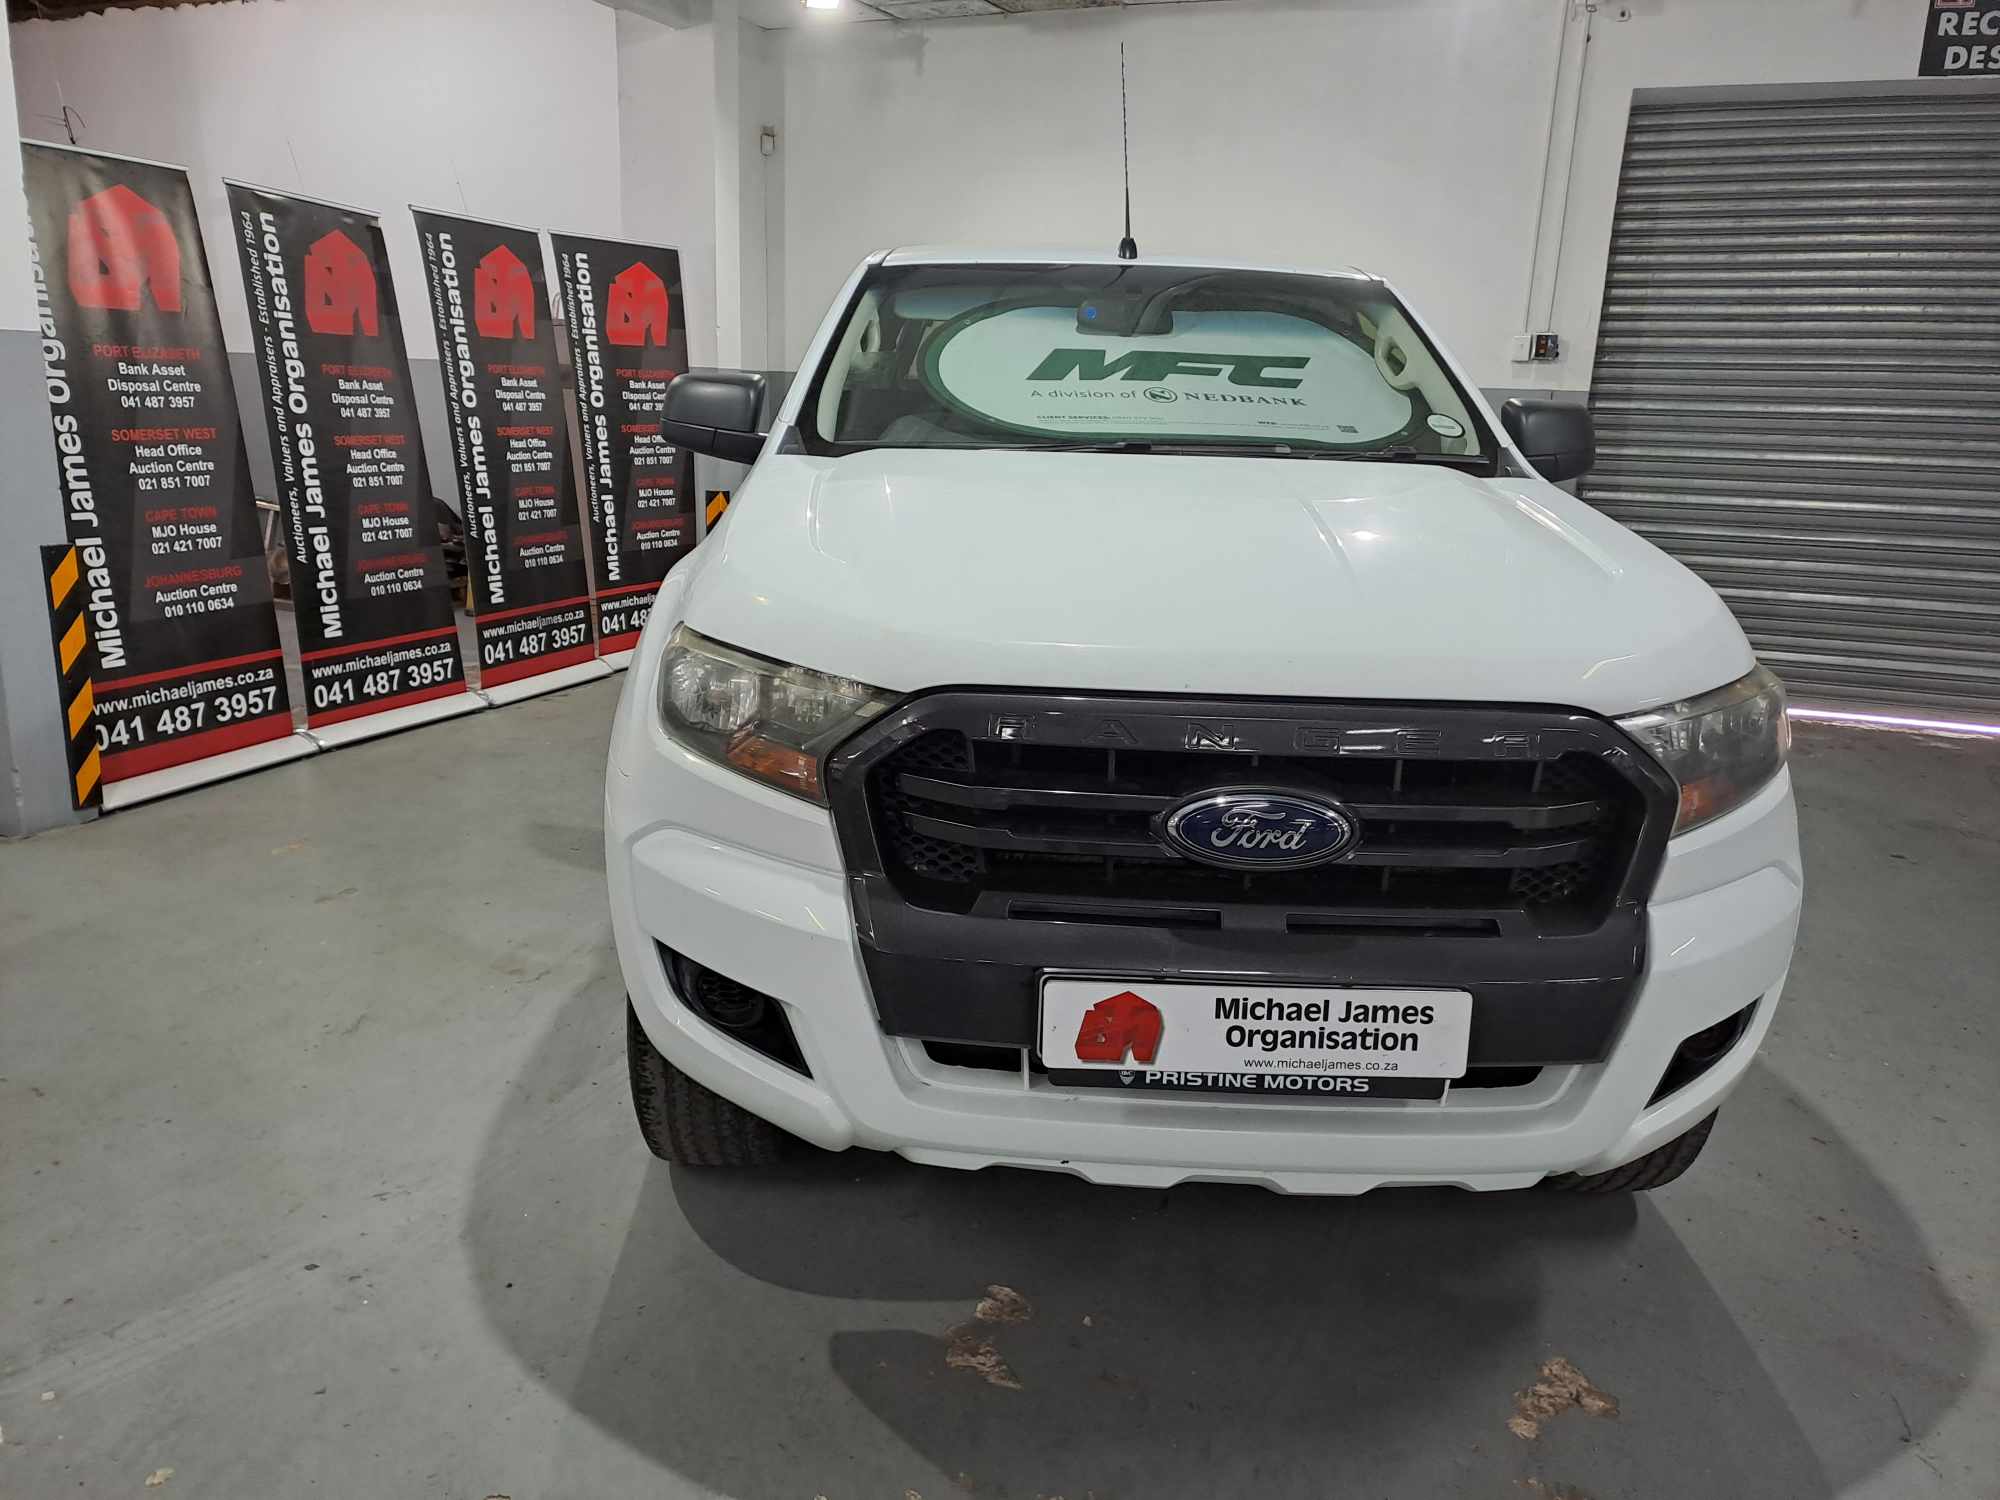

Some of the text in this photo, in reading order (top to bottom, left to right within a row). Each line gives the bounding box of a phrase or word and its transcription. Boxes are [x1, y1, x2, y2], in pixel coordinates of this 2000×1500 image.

[425, 232, 436, 261] 1964
[432, 264, 448, 330] Established
[118, 362, 185, 376] Bank Asset
[443, 340, 458, 401] Appraisers
[1025, 348, 1311, 389] MFC
[108, 379, 201, 394] Disposal Centre
[241, 211, 308, 564] Auctioneers, Valuers and Appraisers Established 1964
[339, 380, 384, 391] Bank Asset
[501, 377, 537, 387] Bank Asset
[121, 396, 195, 408] 041 487 3957
[332, 393, 394, 406] Disposal Centre
[495, 389, 546, 400] Disposal Centre
[1031, 388, 1308, 407] A division of NEDBANK
[341, 408, 390, 418] 041 487 3957
[439, 233, 504, 604] Michael James Organisation
[451, 402, 462, 424] and
[576, 252, 620, 581] Michael James Organisation
[258, 212, 343, 639] Michael James Organisation
[112, 428, 217, 442] SOMERSET WEST
[510, 438, 546, 448] Head Office
[135, 444, 202, 459] Head Office
[351, 448, 397, 460] Head Office
[456, 427, 468, 467] Valuers
[506, 451, 552, 461] Auction Centre
[54, 414, 99, 527] James
[129, 460, 215, 474] Auction Centre
[347, 461, 405, 474] Auction Centre
[138, 475, 211, 490] 021 851 7007
[353, 475, 403, 488] 021 851 7007
[534, 498, 554, 507] House
[152, 522, 217, 538] MJO House
[362, 516, 409, 528] MJO House
[362, 528, 413, 542] 021 421 7007
[151, 537, 222, 554] 021 421 7007
[520, 544, 565, 557] Auction Centre
[364, 568, 424, 584] Auction Centre
[155, 583, 238, 603] Auction Centre
[371, 585, 385, 597] 010
[387, 583, 401, 595] 110
[76, 537, 126, 669] Michael
[164, 598, 234, 618] 010 110 0634
[482, 609, 584, 639] www.michaeljames.co.za
[602, 608, 651, 634] 041 48
[485, 624, 586, 664] 041 487 3957
[312, 641, 451, 678] www.michaeljames.co.za
[92, 667, 274, 716] www.michaeljames.co.za
[314, 657, 454, 708] 041 487 3957
[156, 702, 206, 736] 487
[216, 686, 277, 722] 3957
[1209, 804, 1313, 851] Ford
[1215, 997, 1435, 1025] Michael James
[1225, 1025, 1418, 1051] Organisation
[1243, 1058, 1399, 1071] www.michaeljames.co.za
[1145, 1071, 1257, 1088] PRISTINE
[1263, 1075, 1370, 1092] MOTORS
